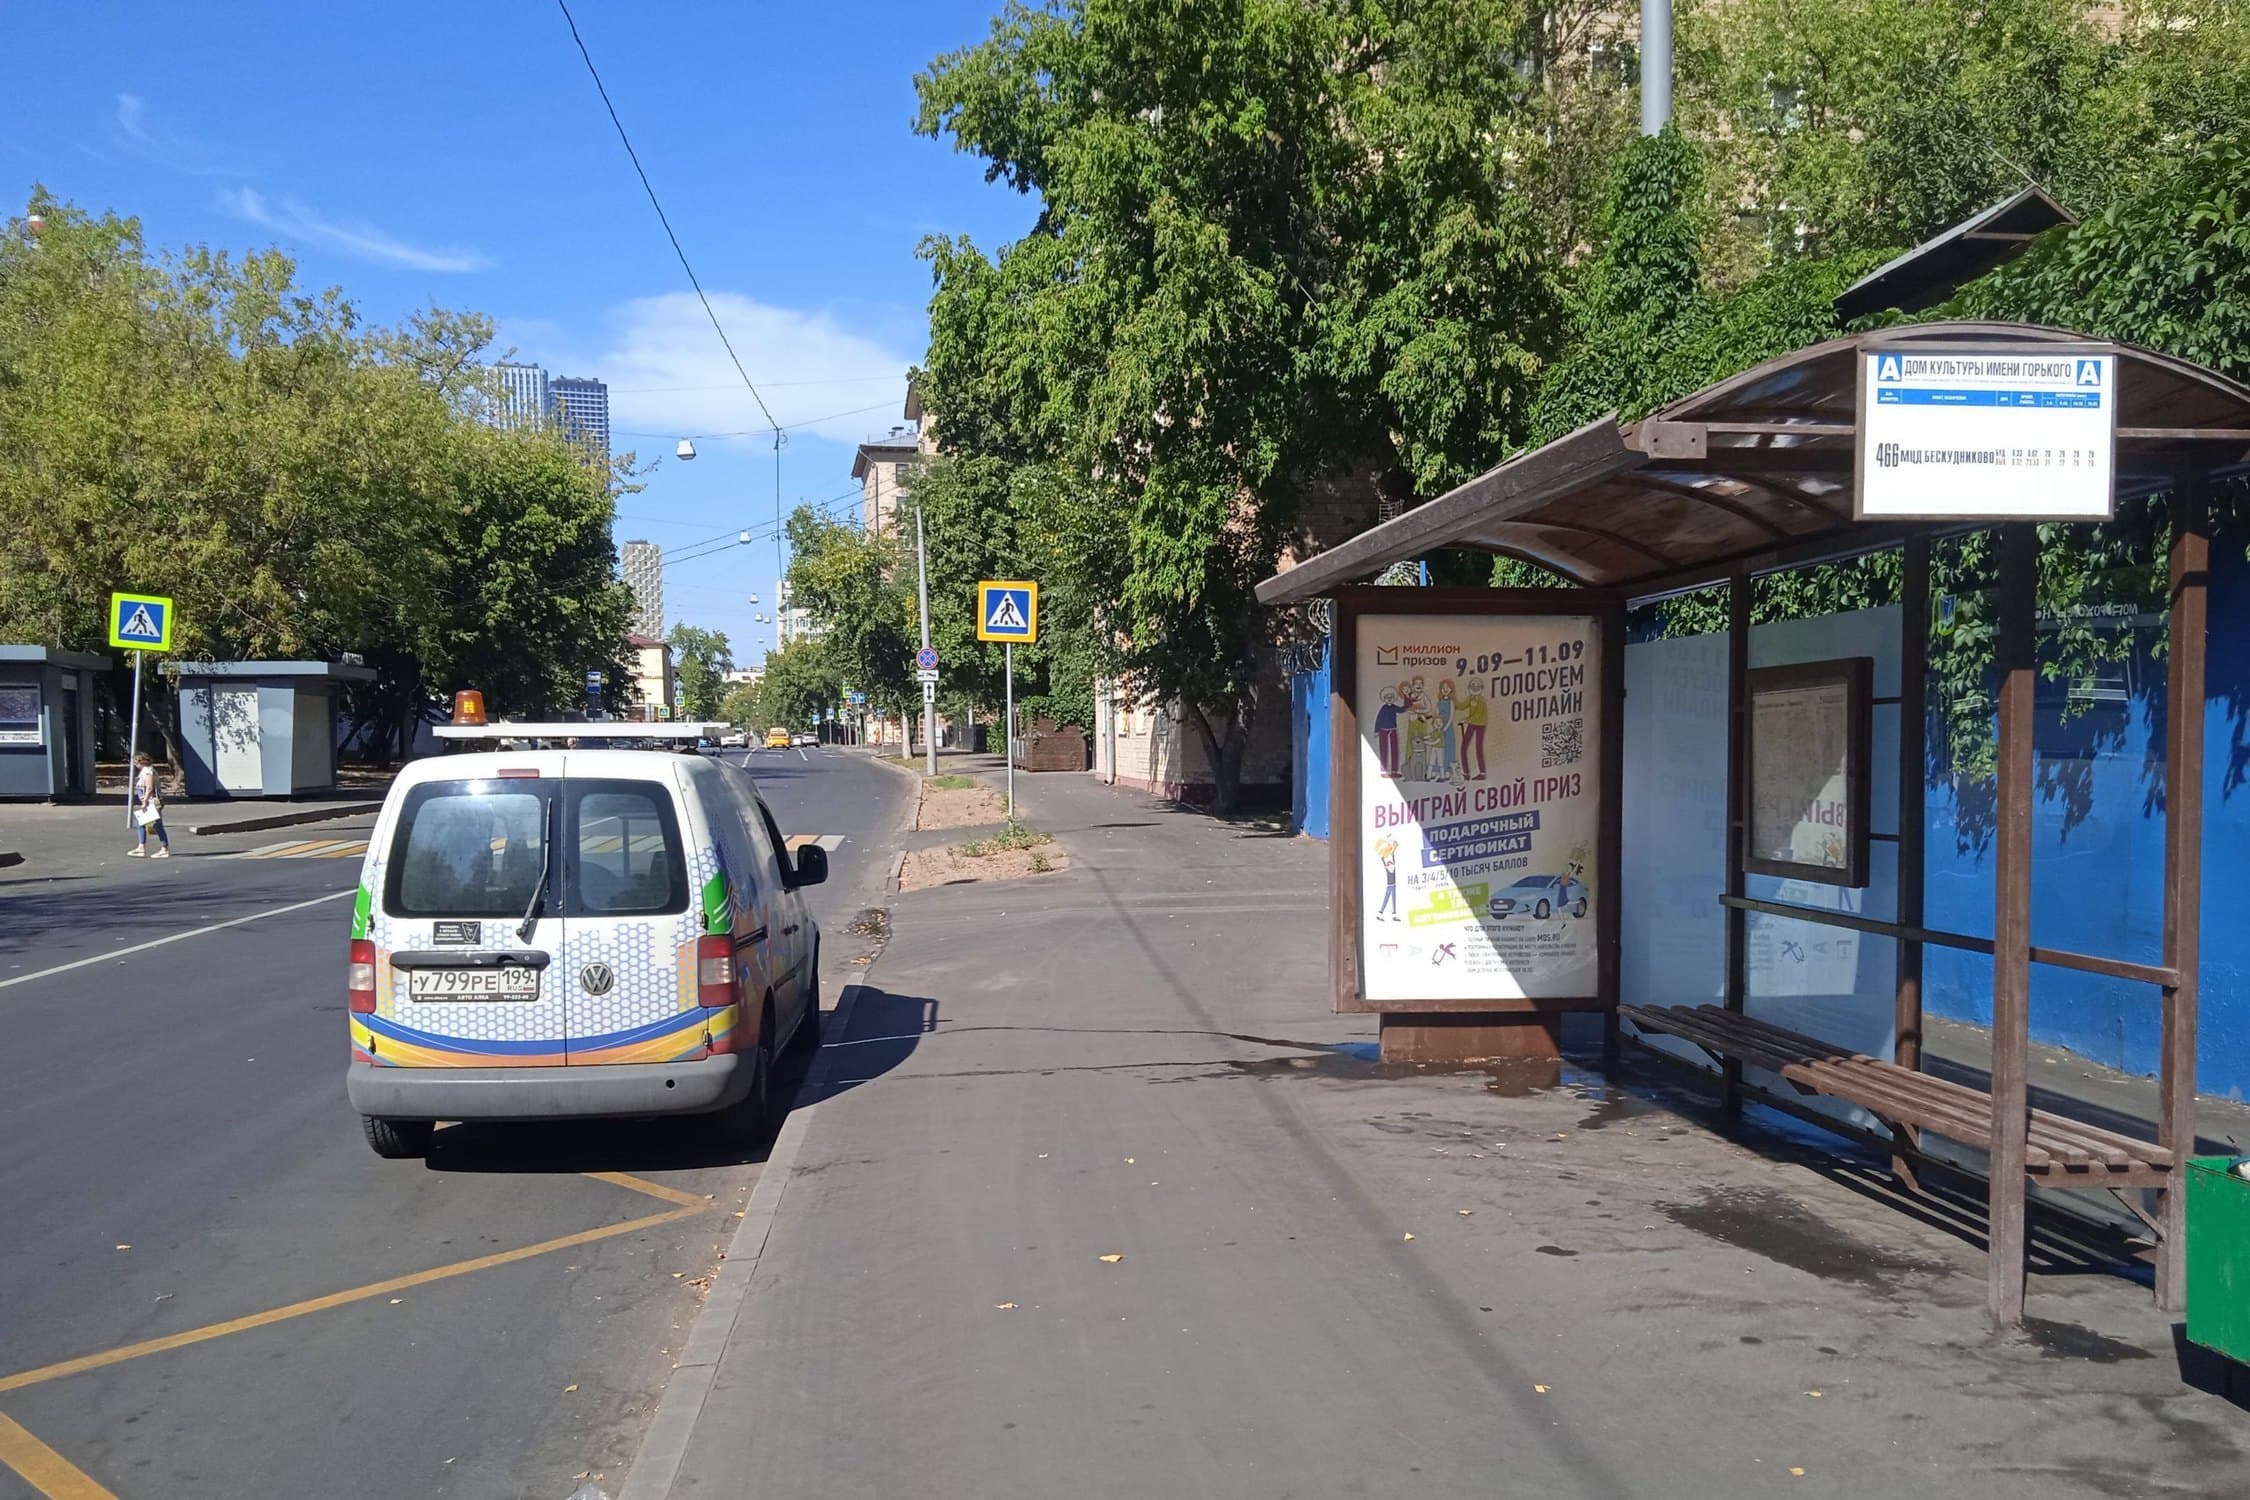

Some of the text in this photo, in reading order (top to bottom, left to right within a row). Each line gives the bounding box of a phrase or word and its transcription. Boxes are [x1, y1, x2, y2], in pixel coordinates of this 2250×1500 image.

[1904, 360, 2072, 378] ДОМ КУЛЬТУРЫ ИМЕНИ ГОРЬКОГО
[1876, 443, 1899, 467] 466
[1900, 450, 1922, 464] МЦД
[1924, 450, 1994, 464] БЕСКУДНИКОВО
[1491, 664, 1584, 698] ГОЛОСУЕМ
[1511, 689, 1583, 722] ОНЛАЙН
[1375, 773, 1581, 828] ВЫИГРАЙ СВОЙ ПРИЗ
[1430, 813, 1535, 842] ПОДАРОЧНЫЙ
[1429, 836, 1527, 862] СЕРТИФИКАТ
[1408, 872, 1419, 885] НА
[1461, 862, 1491, 877] ТЫСЯЧ
[1493, 857, 1528, 872] БАЛЛОВ
[502, 970, 532, 984] 199
